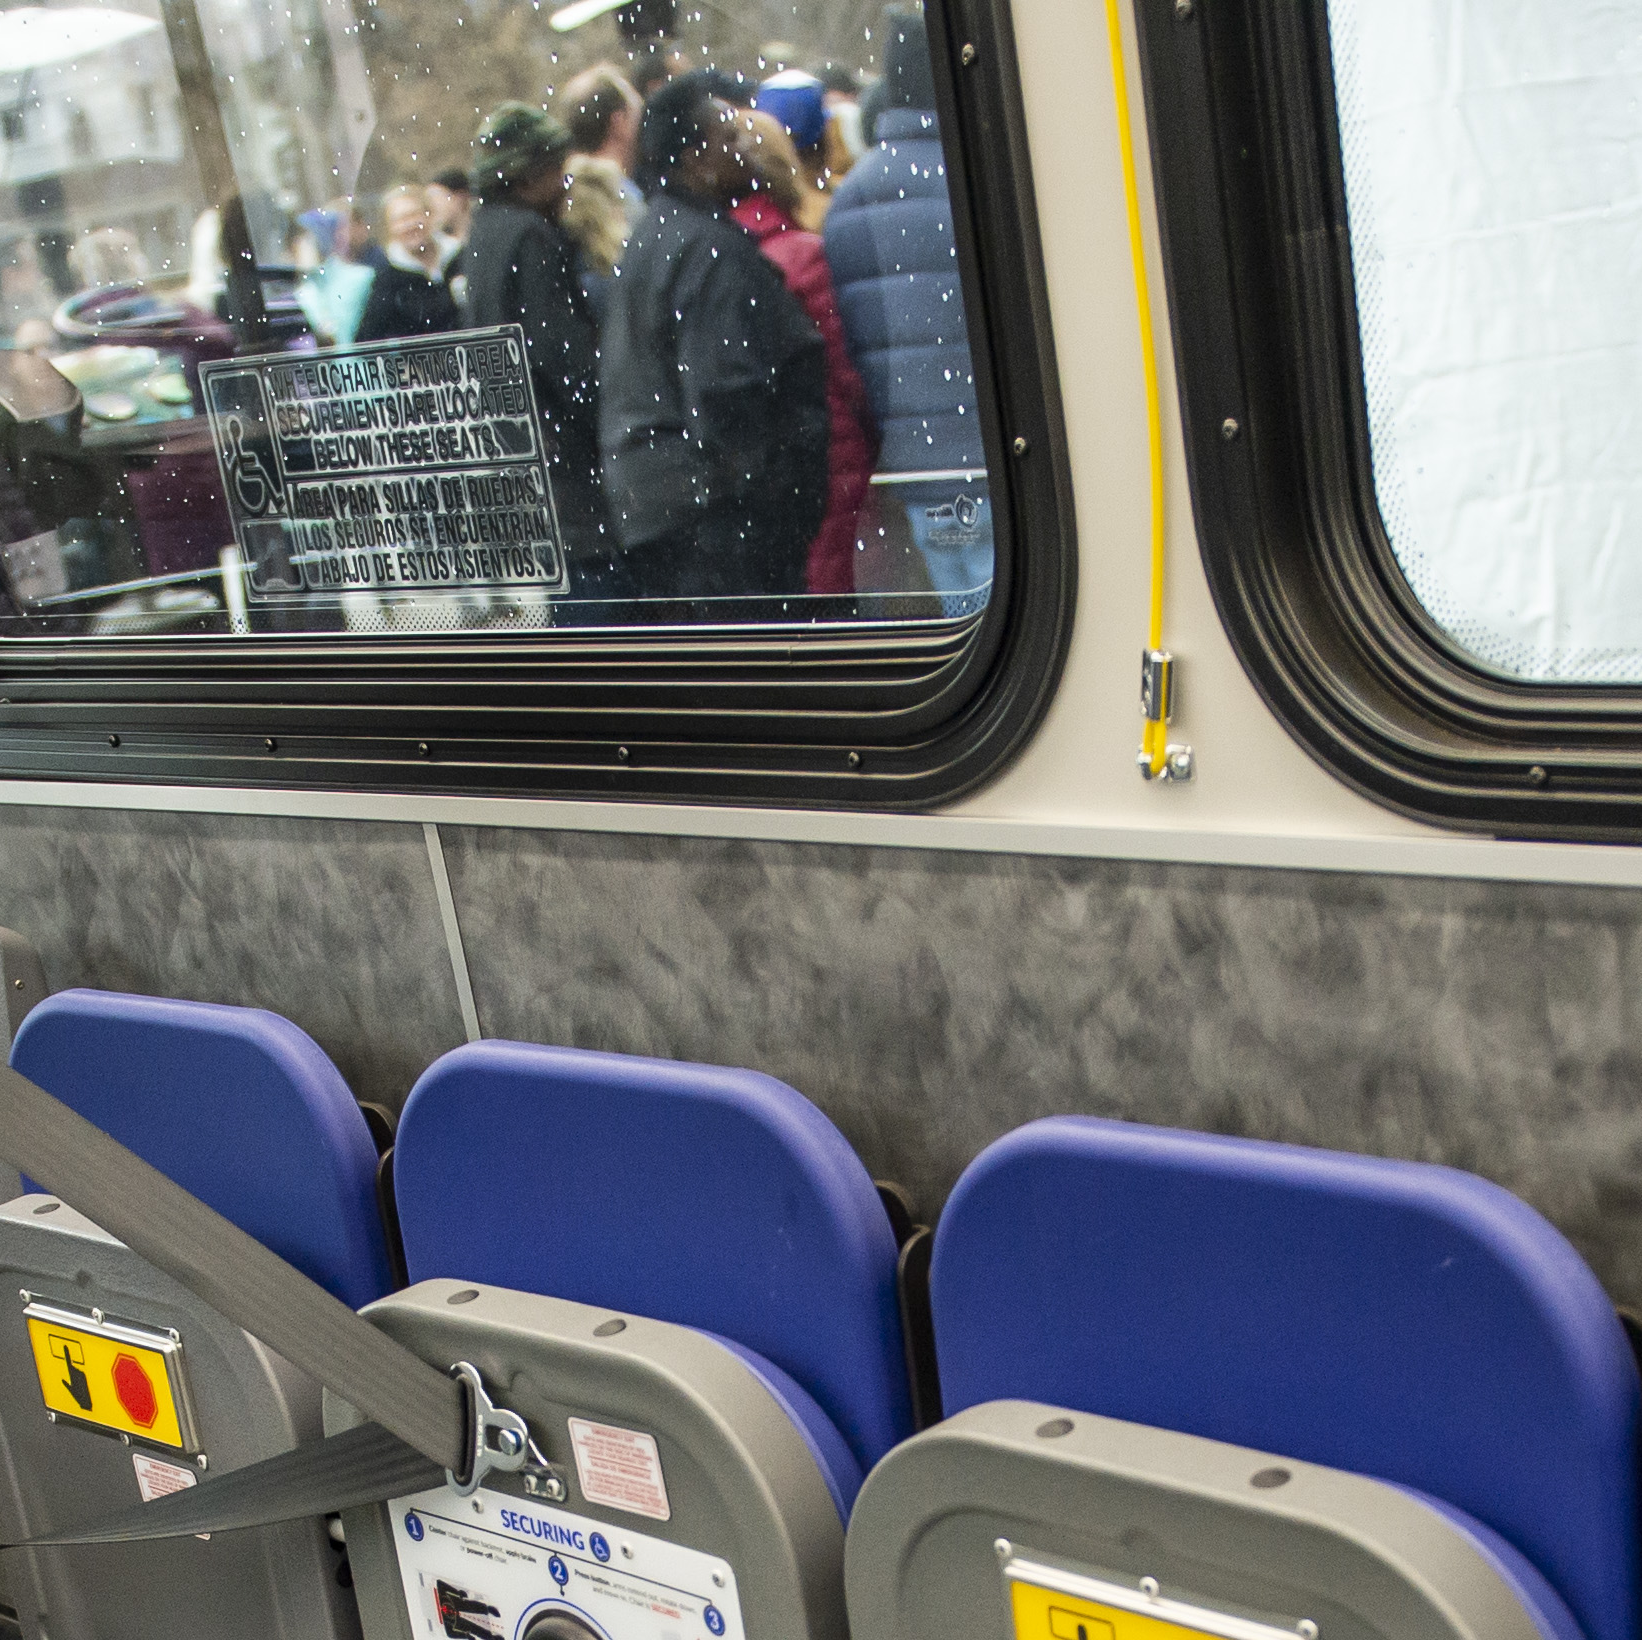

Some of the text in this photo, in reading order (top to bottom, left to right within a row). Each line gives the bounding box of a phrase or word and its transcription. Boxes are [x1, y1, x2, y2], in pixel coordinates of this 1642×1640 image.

[384, 349, 462, 388] SEATING
[276, 383, 527, 437] SECUREMENTS ARE LOCATED
[314, 435, 373, 469] BELOW
[375, 427, 433, 466] THESE
[335, 482, 382, 519] PARA
[383, 477, 439, 514] SILLAS
[441, 476, 465, 510] DE
[302, 508, 548, 552] LOS SEGUROS SE ENCUENTRAN
[321, 545, 542, 583] ABAJO DE ESTOS ASIENTOS.
[500, 1509, 586, 1551] SECURING
